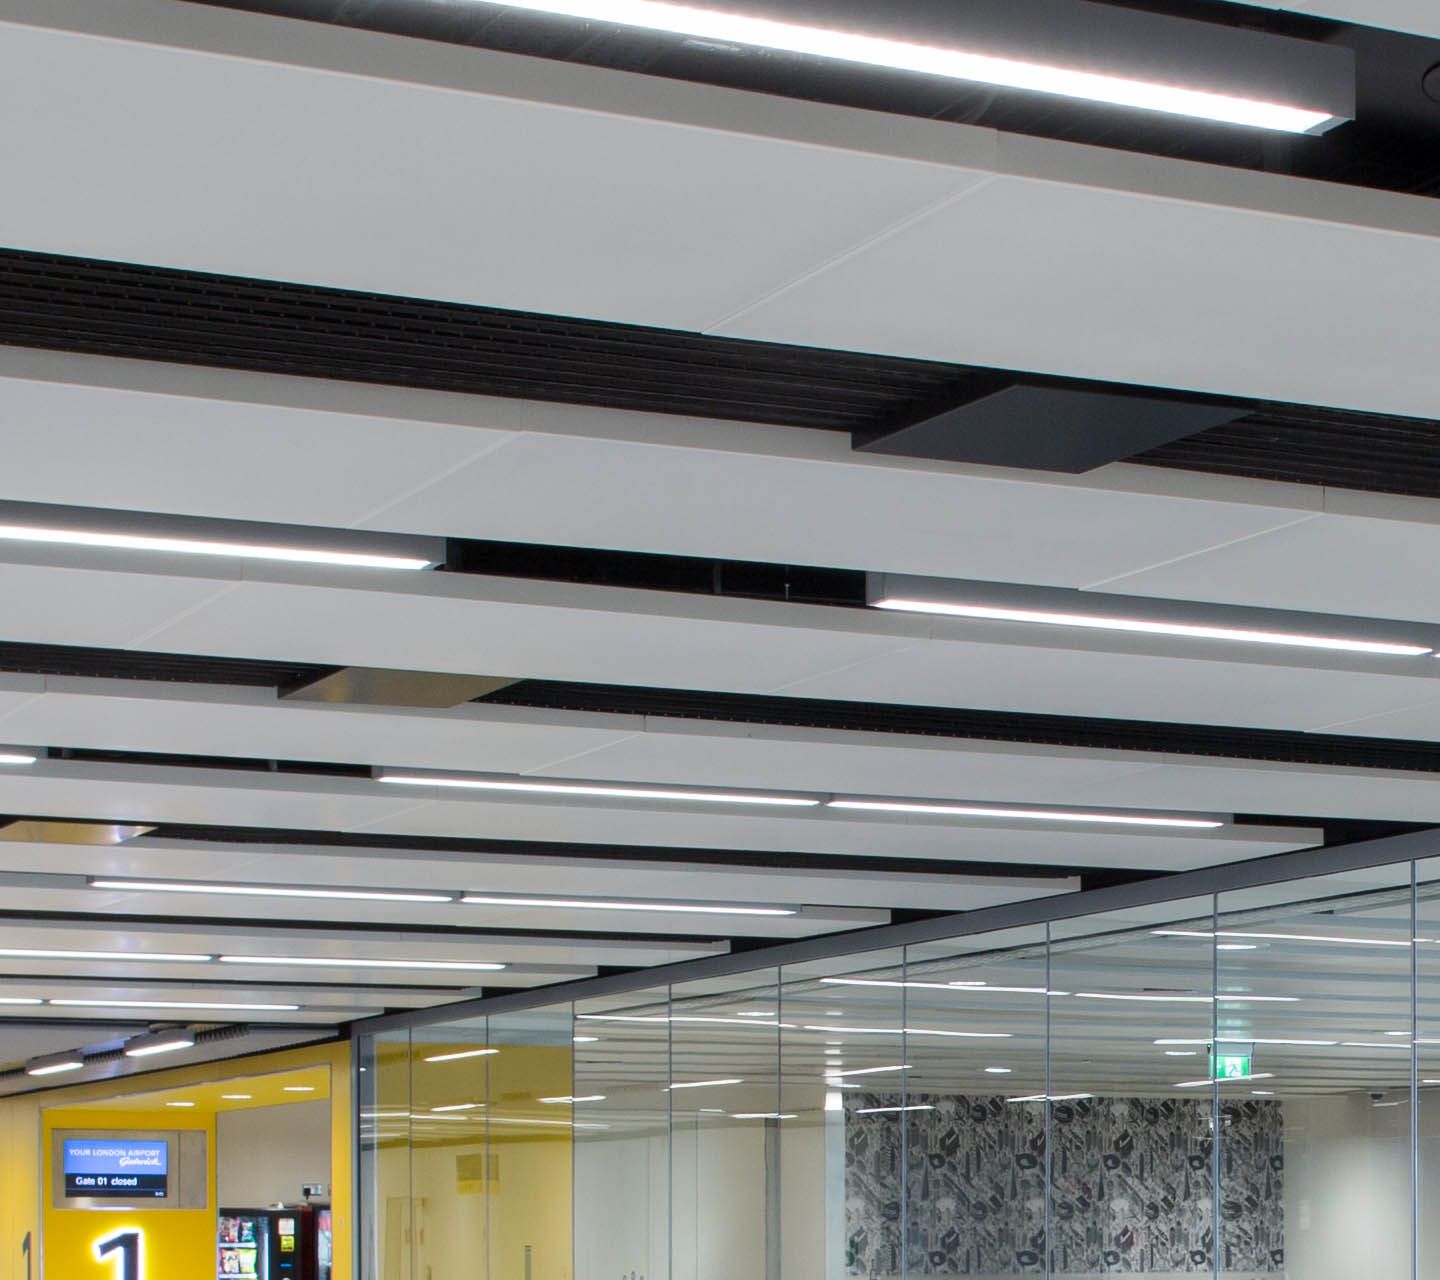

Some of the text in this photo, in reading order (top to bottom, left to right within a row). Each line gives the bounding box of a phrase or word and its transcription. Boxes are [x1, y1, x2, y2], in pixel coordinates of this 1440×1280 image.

[128, 1149, 160, 1157] AIRPORT
[75, 1176, 138, 1186] Gate 01 closed
